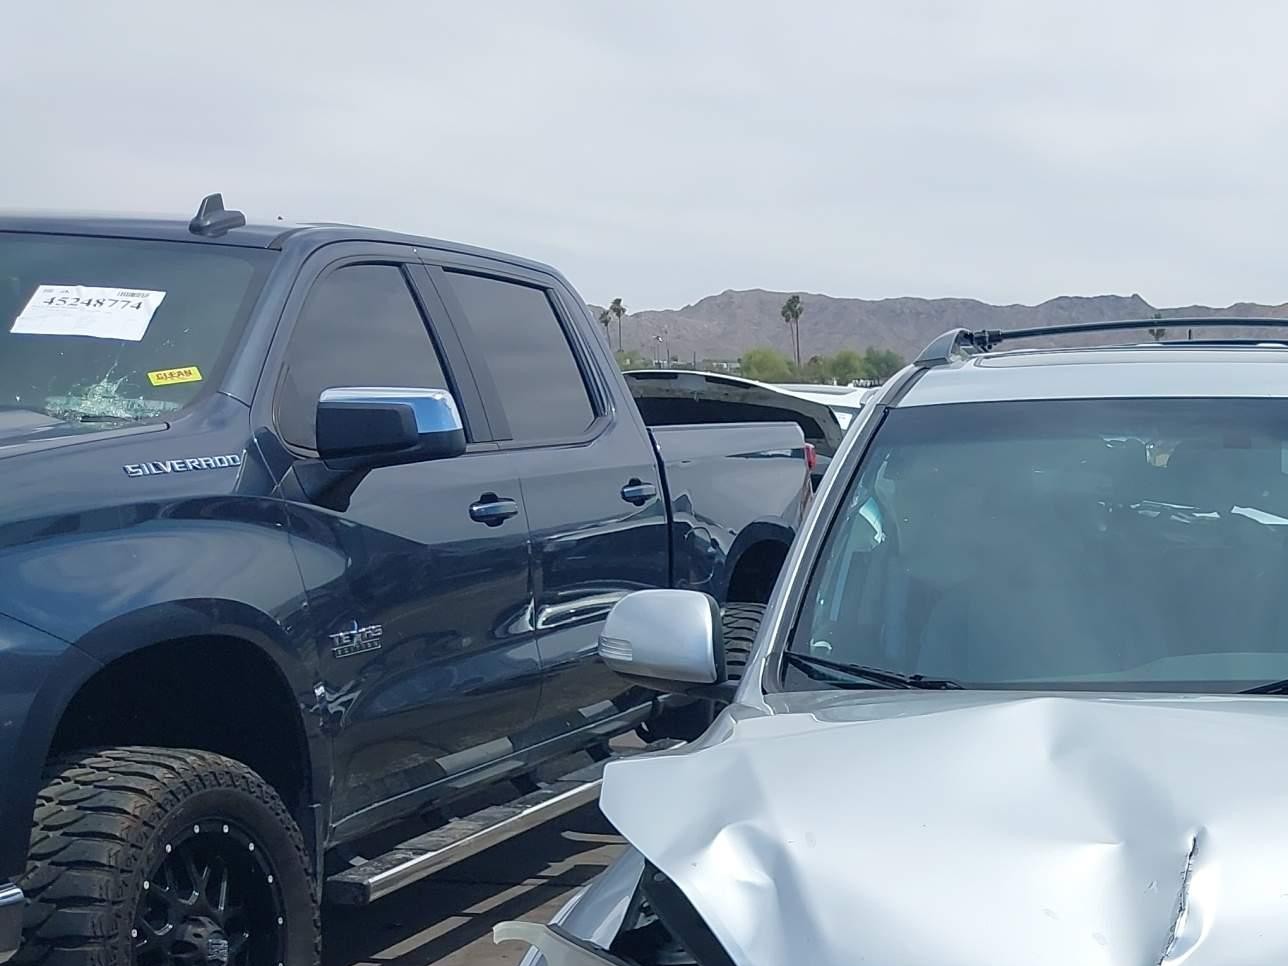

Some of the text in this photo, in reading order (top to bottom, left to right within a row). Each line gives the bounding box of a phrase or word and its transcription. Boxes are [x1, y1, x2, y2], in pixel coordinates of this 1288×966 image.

[43, 296, 143, 310] 45248774
[154, 369, 193, 381] CLEAN
[123, 455, 241, 478] SILVERADO
